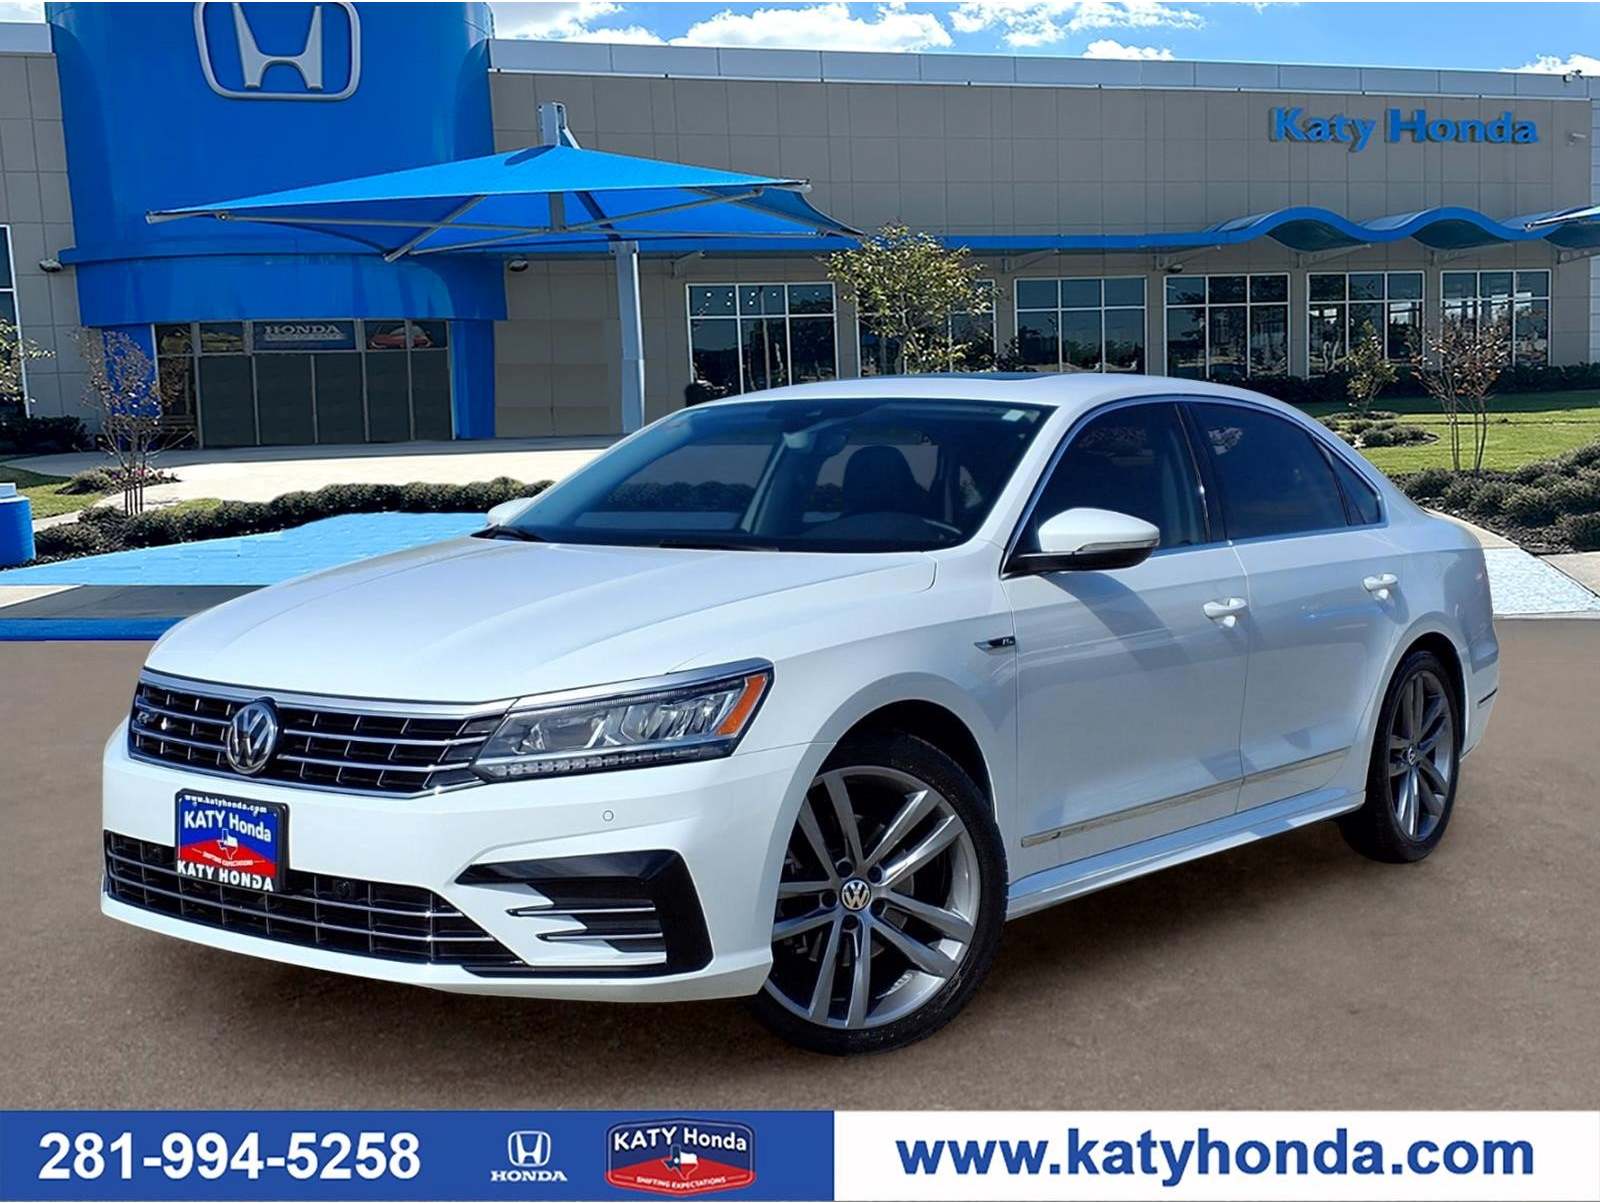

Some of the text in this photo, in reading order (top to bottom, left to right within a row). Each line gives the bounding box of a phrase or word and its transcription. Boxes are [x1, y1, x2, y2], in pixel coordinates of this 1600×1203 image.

[1270, 106, 1539, 152] Katy Honda
[264, 324, 342, 334] HONDA
[184, 810, 272, 843] KATY Honda
[177, 859, 215, 880] KATY
[218, 868, 274, 892] HONDA
